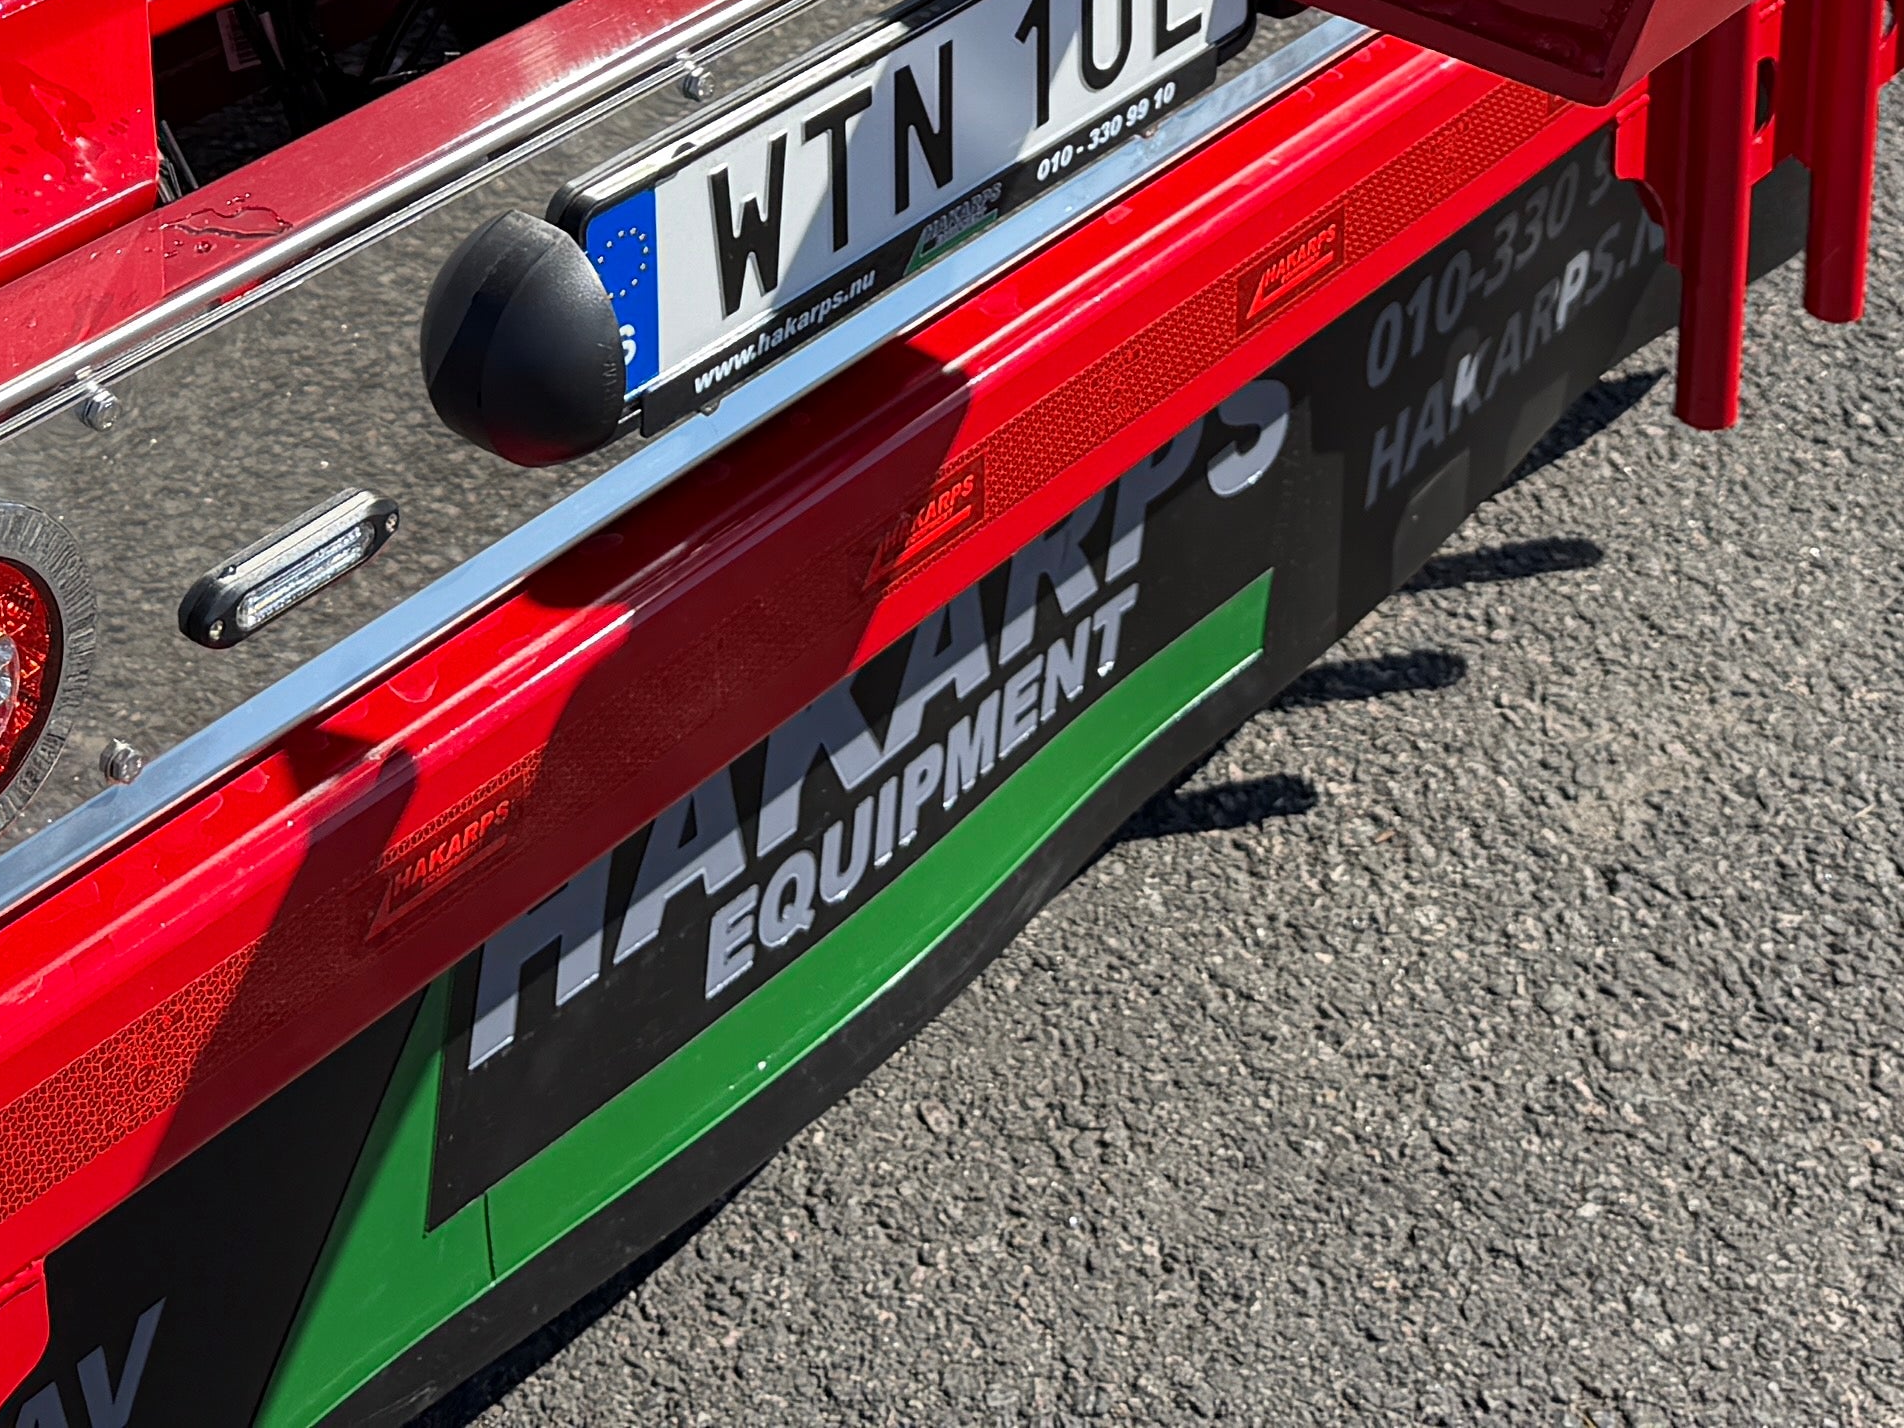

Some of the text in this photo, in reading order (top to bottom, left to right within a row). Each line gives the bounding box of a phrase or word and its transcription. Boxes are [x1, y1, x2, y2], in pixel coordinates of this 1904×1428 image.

[706, 41, 956, 321] WTN
[1036, 144, 1073, 181] 010
[1088, 115, 1122, 152] 330
[1126, 97, 1150, 127] 99
[1154, 81, 1177, 110] 10
[1264, 223, 1336, 288] HAKARPS
[1366, 161, 1581, 389] 010-330
[694, 270, 876, 394] www.hakarps.nu
[393, 799, 510, 897] HAKARPS
[704, 583, 1141, 1001] EQUIPMENT
